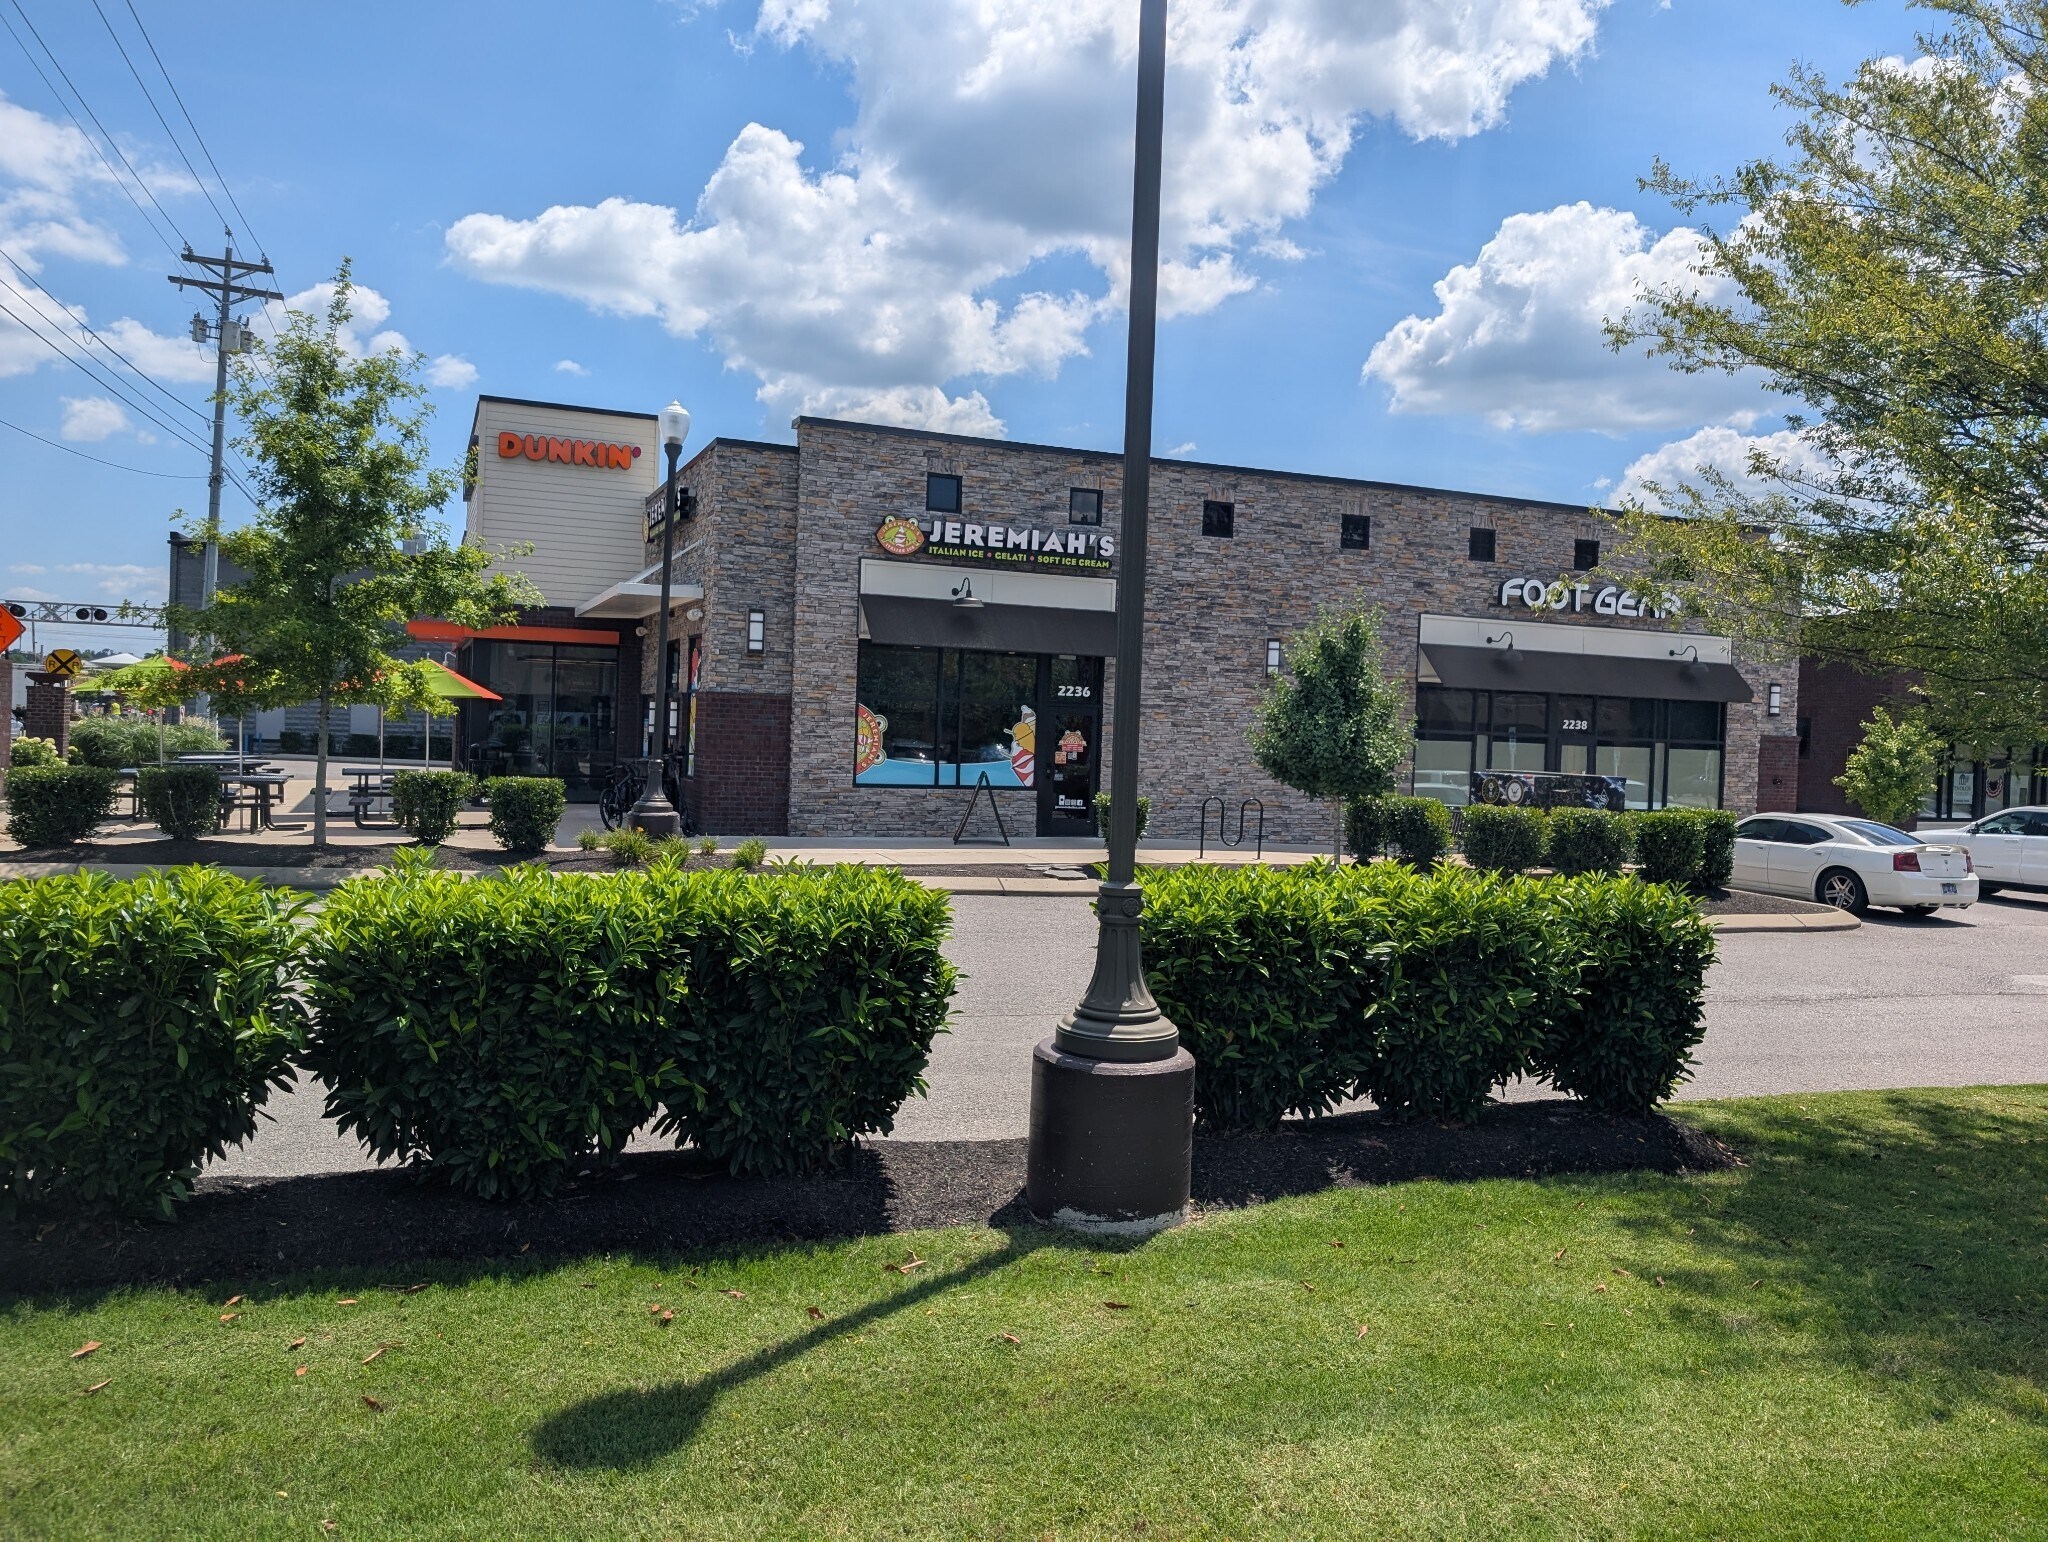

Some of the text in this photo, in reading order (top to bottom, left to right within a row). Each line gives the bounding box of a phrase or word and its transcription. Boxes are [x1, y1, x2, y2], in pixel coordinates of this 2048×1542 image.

[929, 520, 1115, 556] JEREMIAH'S
[929, 546, 1109, 569] ITALIAN ICE GELATI SOFT ICE CREAM
[1501, 578, 1590, 612] FOOT
[1058, 685, 1091, 698] 2236
[1562, 719, 1588, 730] 2238
[862, 712, 879, 768] JEREMIAH'S
